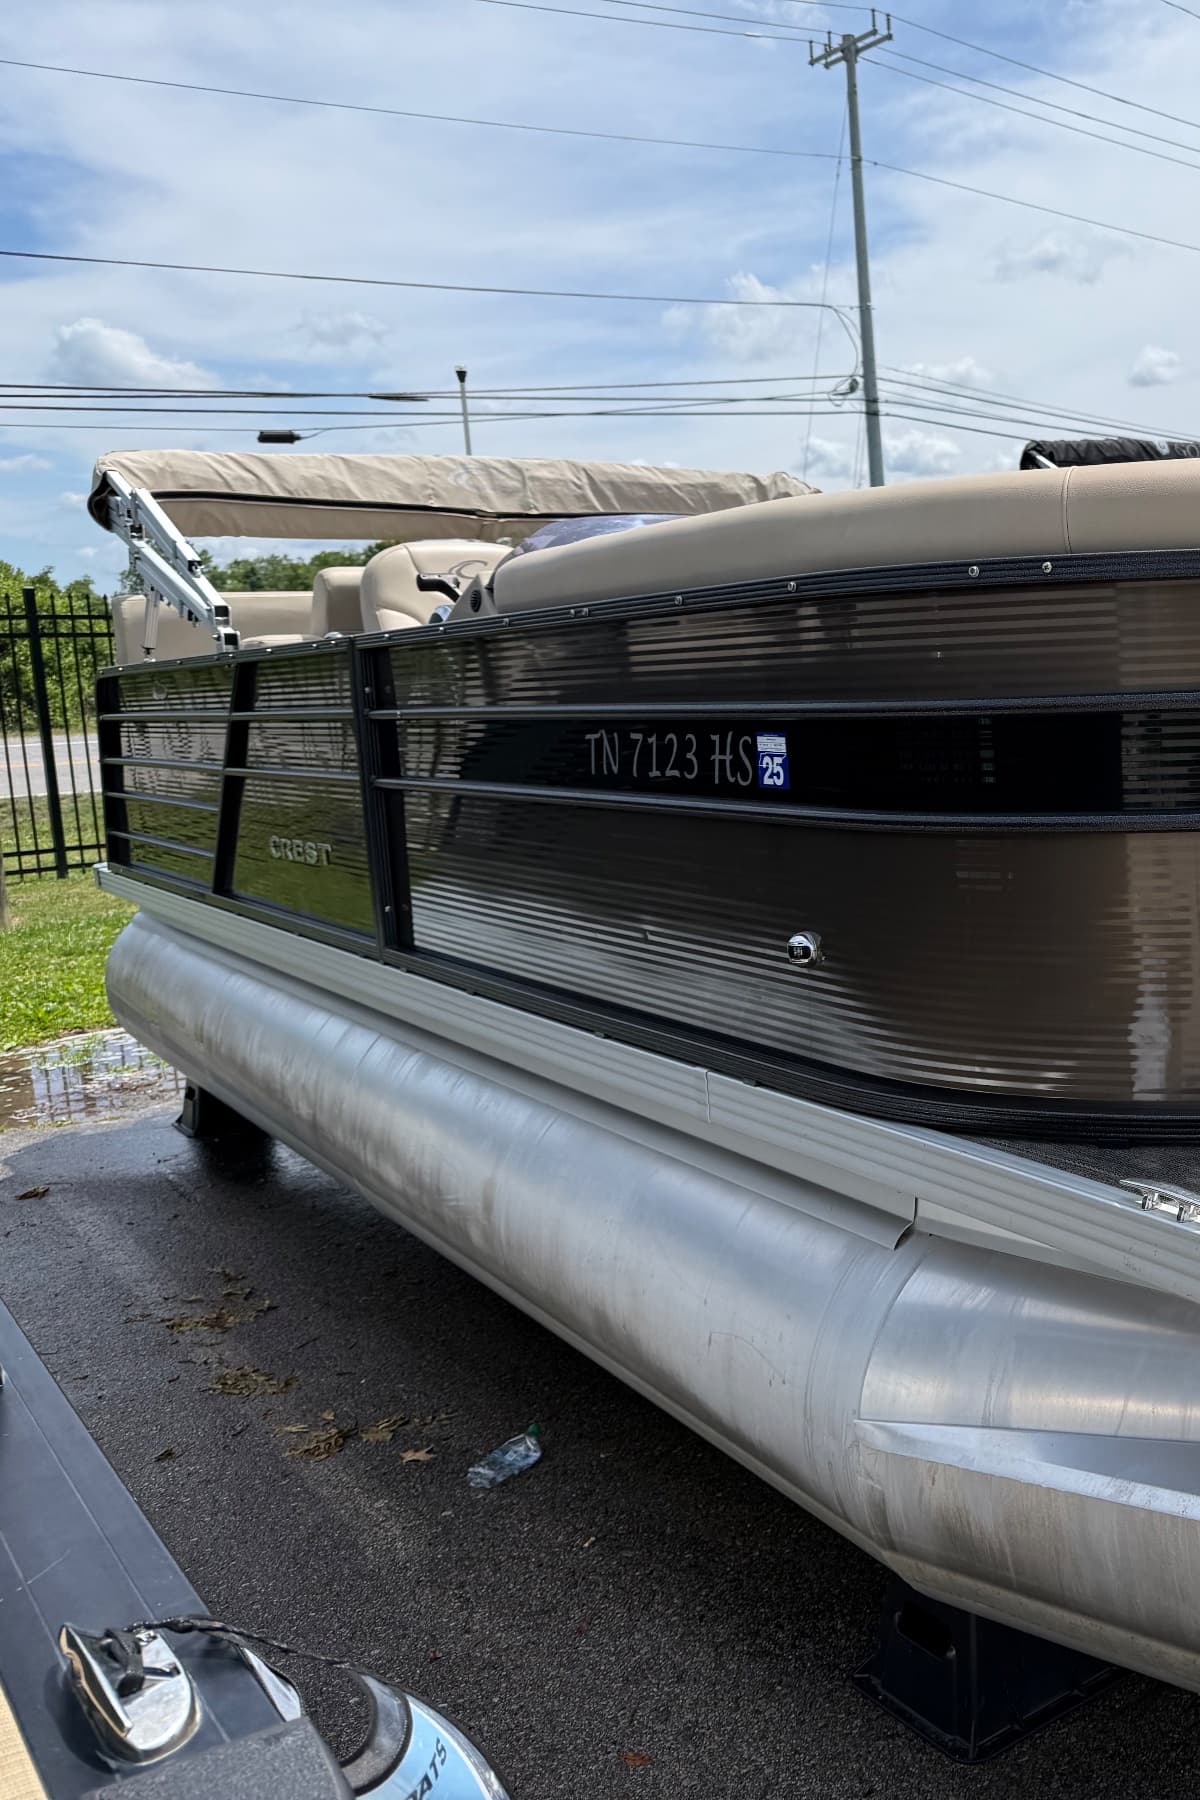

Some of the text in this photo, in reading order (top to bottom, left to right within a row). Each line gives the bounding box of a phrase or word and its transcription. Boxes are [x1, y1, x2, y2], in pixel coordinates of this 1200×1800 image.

[584, 729, 753, 786] TN 7123 HS
[762, 755, 785, 786] 25
[270, 835, 332, 866] CREST
